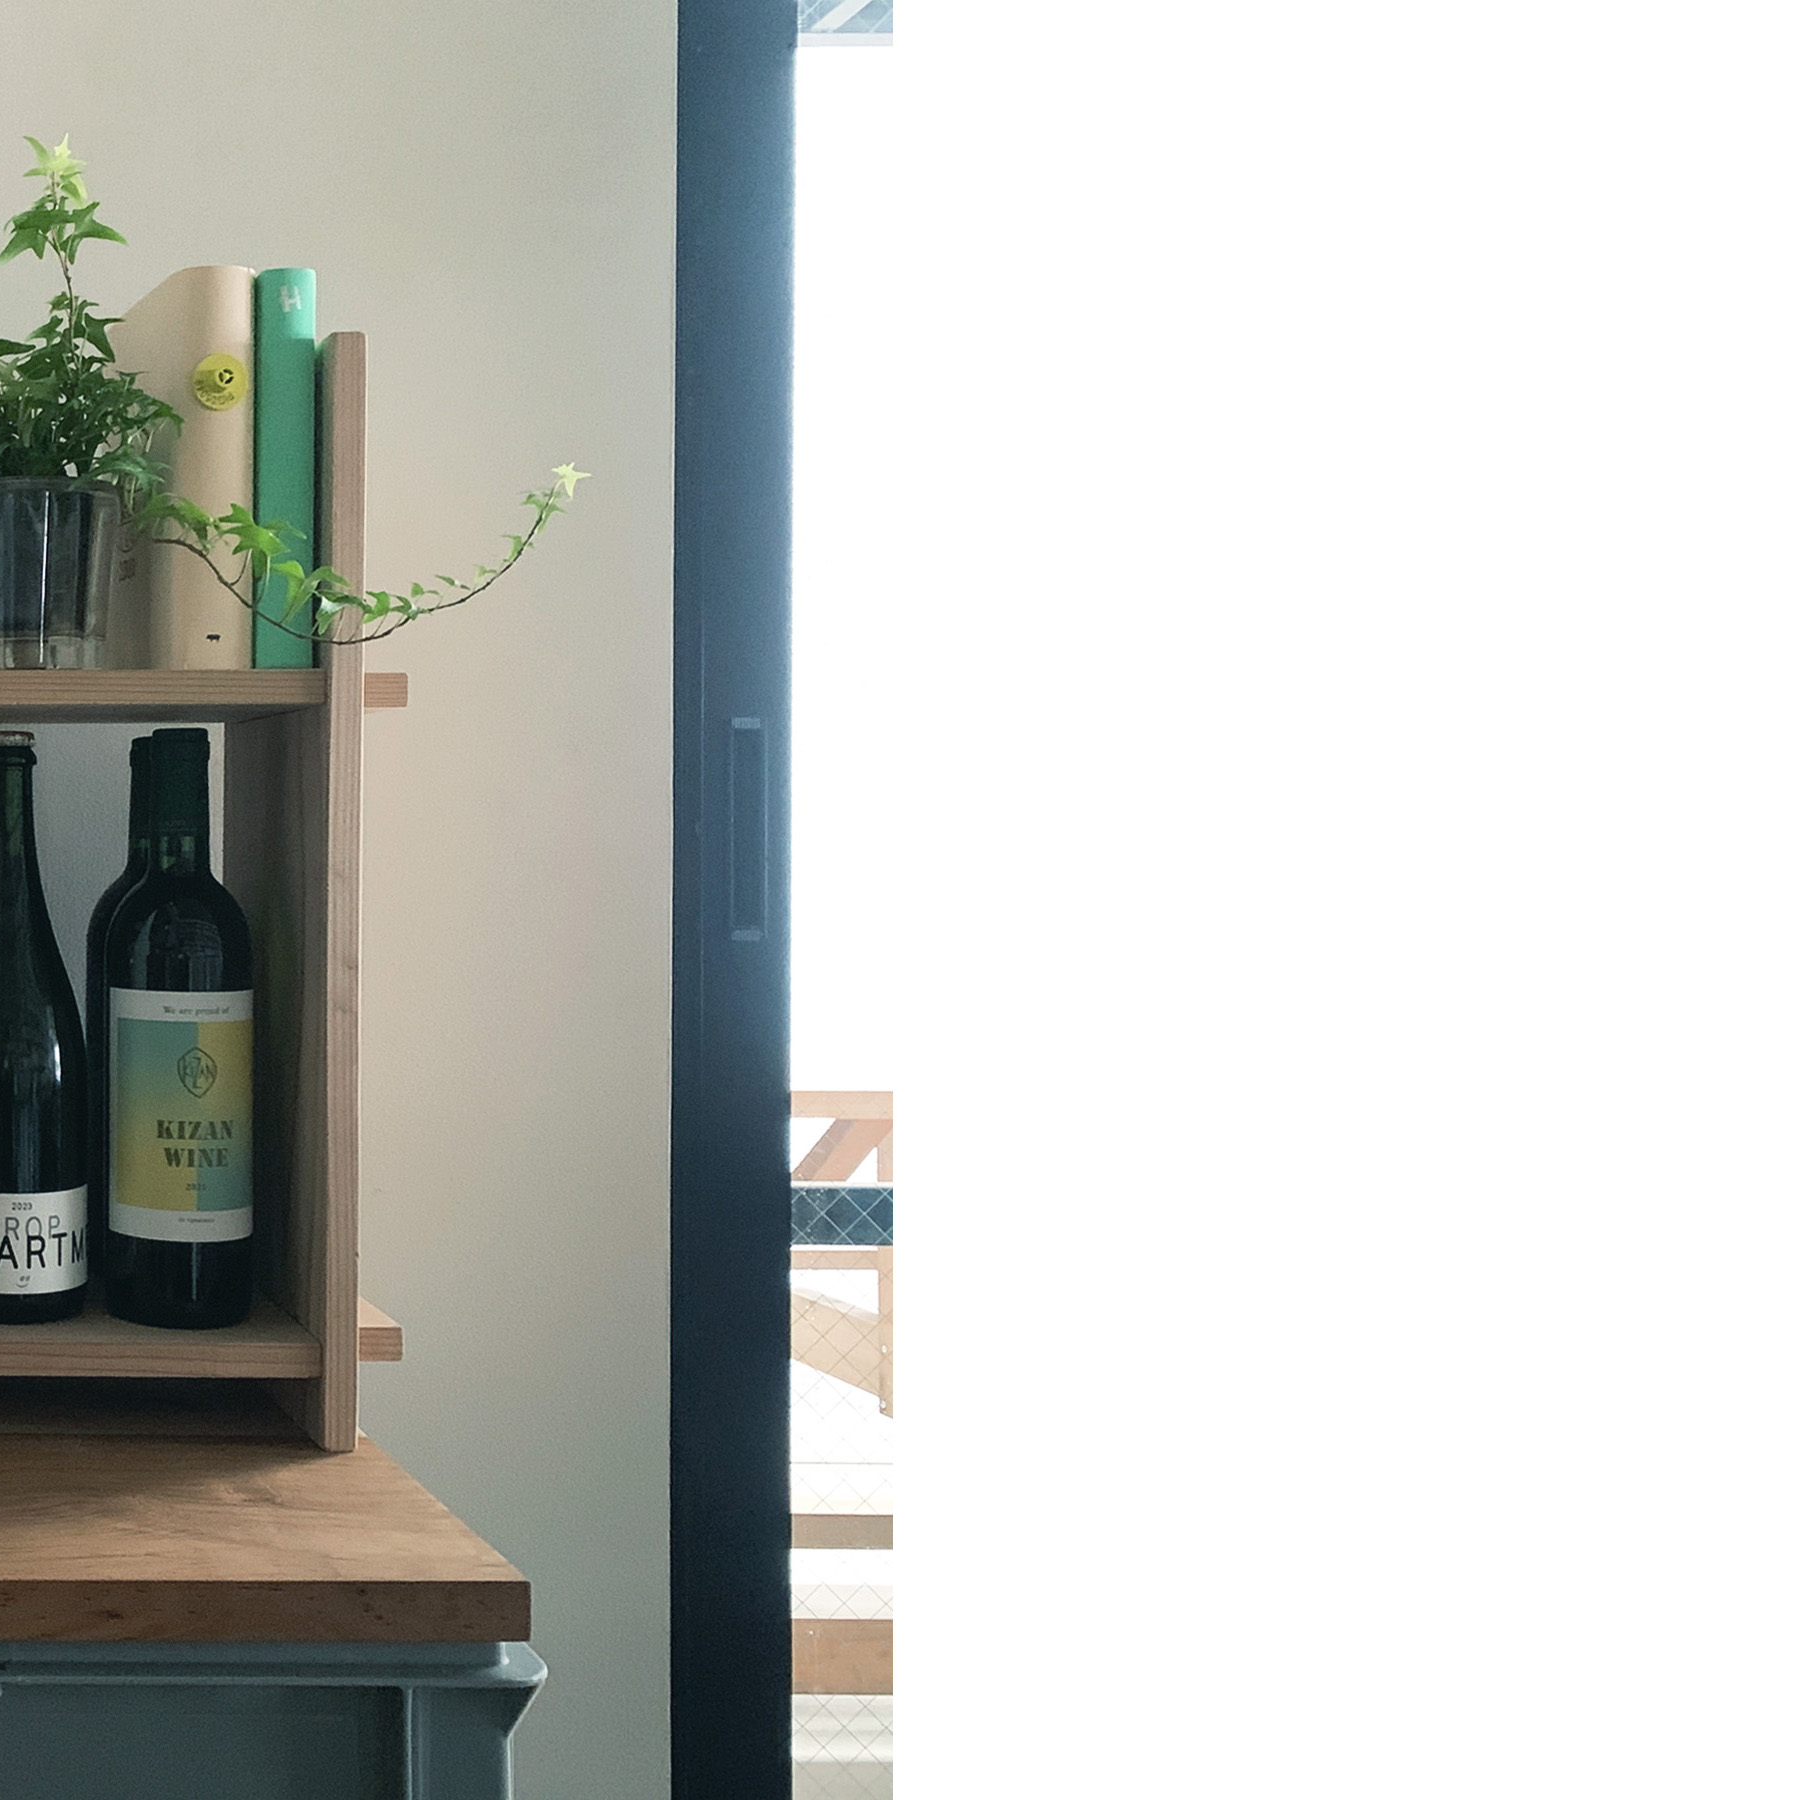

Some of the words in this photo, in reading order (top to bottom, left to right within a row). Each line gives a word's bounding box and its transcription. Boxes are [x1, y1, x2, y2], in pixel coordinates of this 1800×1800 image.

[163, 1006, 176, 1015] We
[195, 1006, 220, 1017] proud
[221, 1005, 230, 1015] of
[157, 1119, 234, 1140] KIZAN
[163, 1147, 228, 1168] WINE
